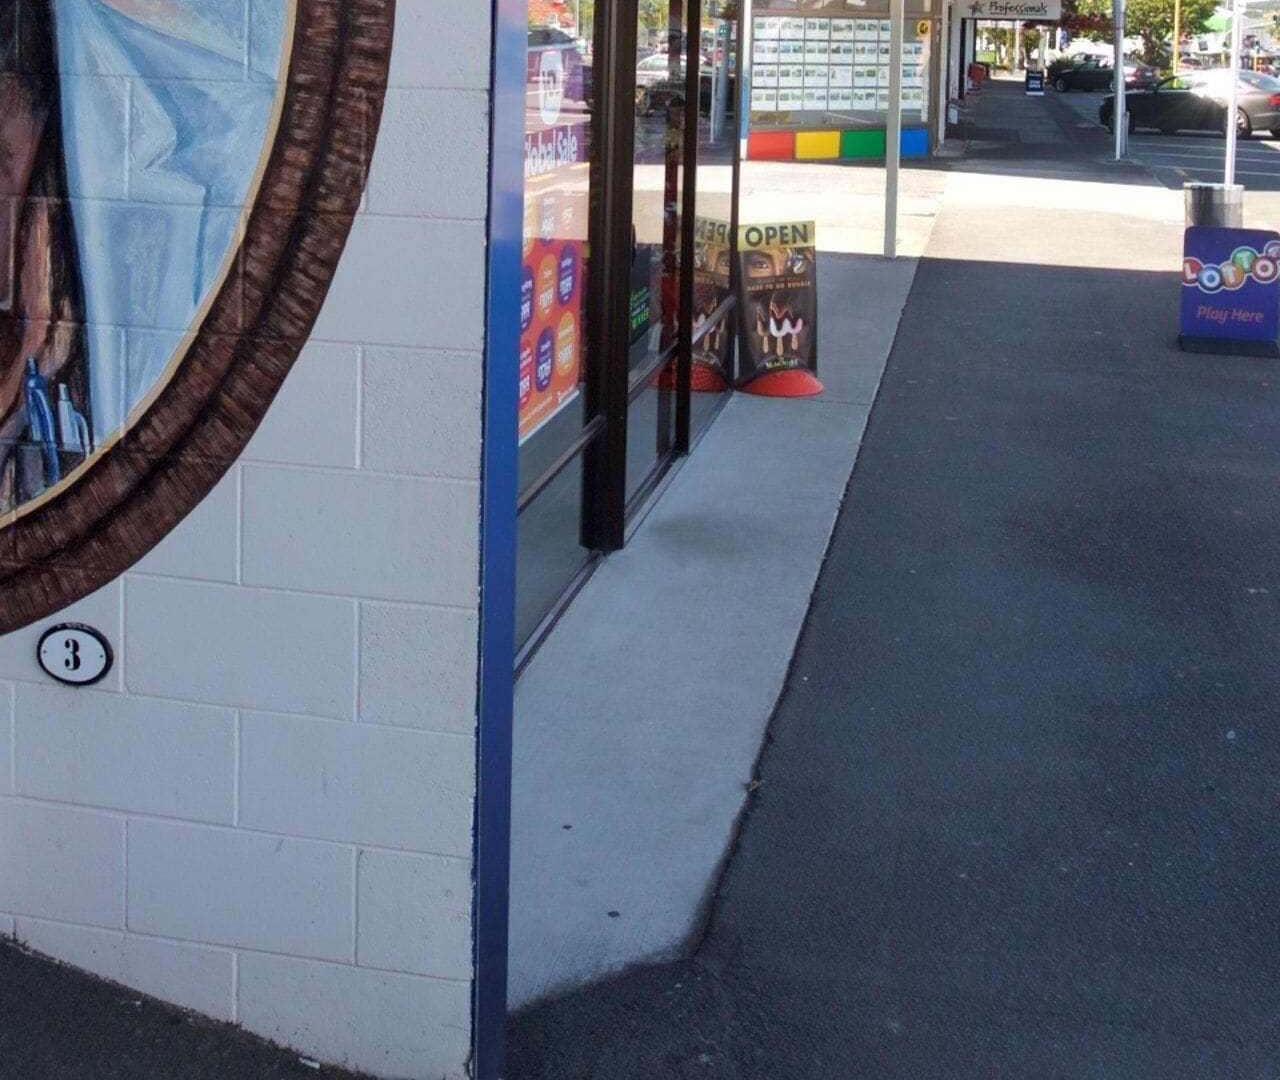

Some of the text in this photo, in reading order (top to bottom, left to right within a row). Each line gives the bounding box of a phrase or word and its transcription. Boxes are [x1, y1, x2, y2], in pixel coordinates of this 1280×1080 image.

[989, 1, 1048, 16] Professionals
[557, 124, 578, 166] Sale
[745, 224, 808, 247] OPEN
[1184, 251, 1275, 288] LOTTO
[1197, 306, 1264, 324] Play Here
[65, 638, 80, 671] 3
